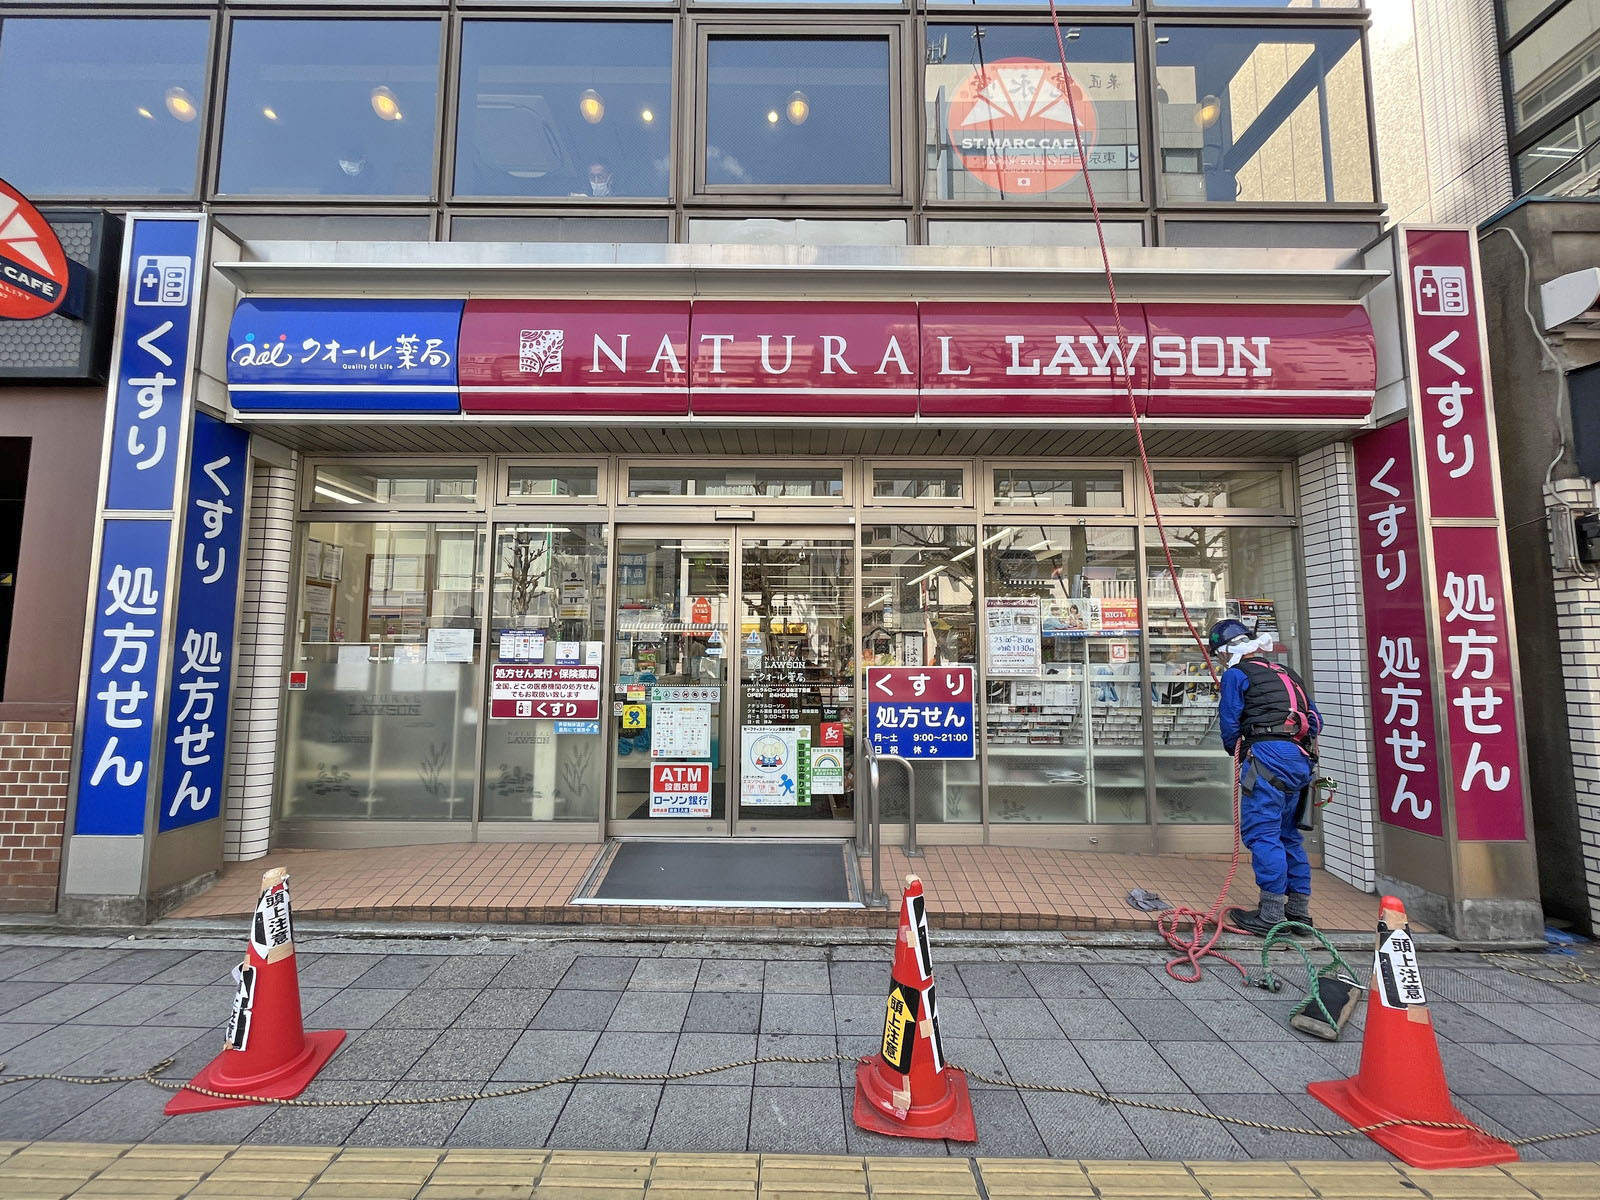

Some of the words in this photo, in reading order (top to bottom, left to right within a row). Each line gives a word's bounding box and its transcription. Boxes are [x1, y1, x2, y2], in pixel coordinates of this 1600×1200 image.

[961, 137, 1037, 150] ST.MARC
[4, 265, 55, 298] CAFÉ
[300, 333, 451, 370] クオール薬局
[342, 363, 367, 371] Quality
[589, 333, 972, 376] NATURAL
[1005, 335, 1272, 377] LAWSON
[128, 320, 176, 470] くすり
[1426, 330, 1474, 478] くすり
[196, 455, 233, 584] くすり
[1368, 457, 1407, 591] くすり
[90, 564, 158, 786] 処方せん
[495, 668, 597, 679] 処方せん受付・保険薬局
[759, 672, 806, 683] クオール薬局
[764, 661, 806, 669] LAWSON
[1443, 571, 1510, 792] 処方せん
[875, 673, 964, 697] くすり
[169, 628, 221, 817] 処方せん
[536, 702, 577, 716] くすり
[876, 705, 965, 728] 処方せん
[1378, 635, 1432, 820] 処方せん
[874, 746, 882, 754] 日
[890, 746, 899, 754] 祝
[659, 767, 701, 782] ATM
[654, 795, 708, 806] ローソン銀行
[265, 891, 289, 947] 頭上注意
[1390, 937, 1422, 1000] 頭上注意
[884, 994, 905, 1060] 頭上注意
